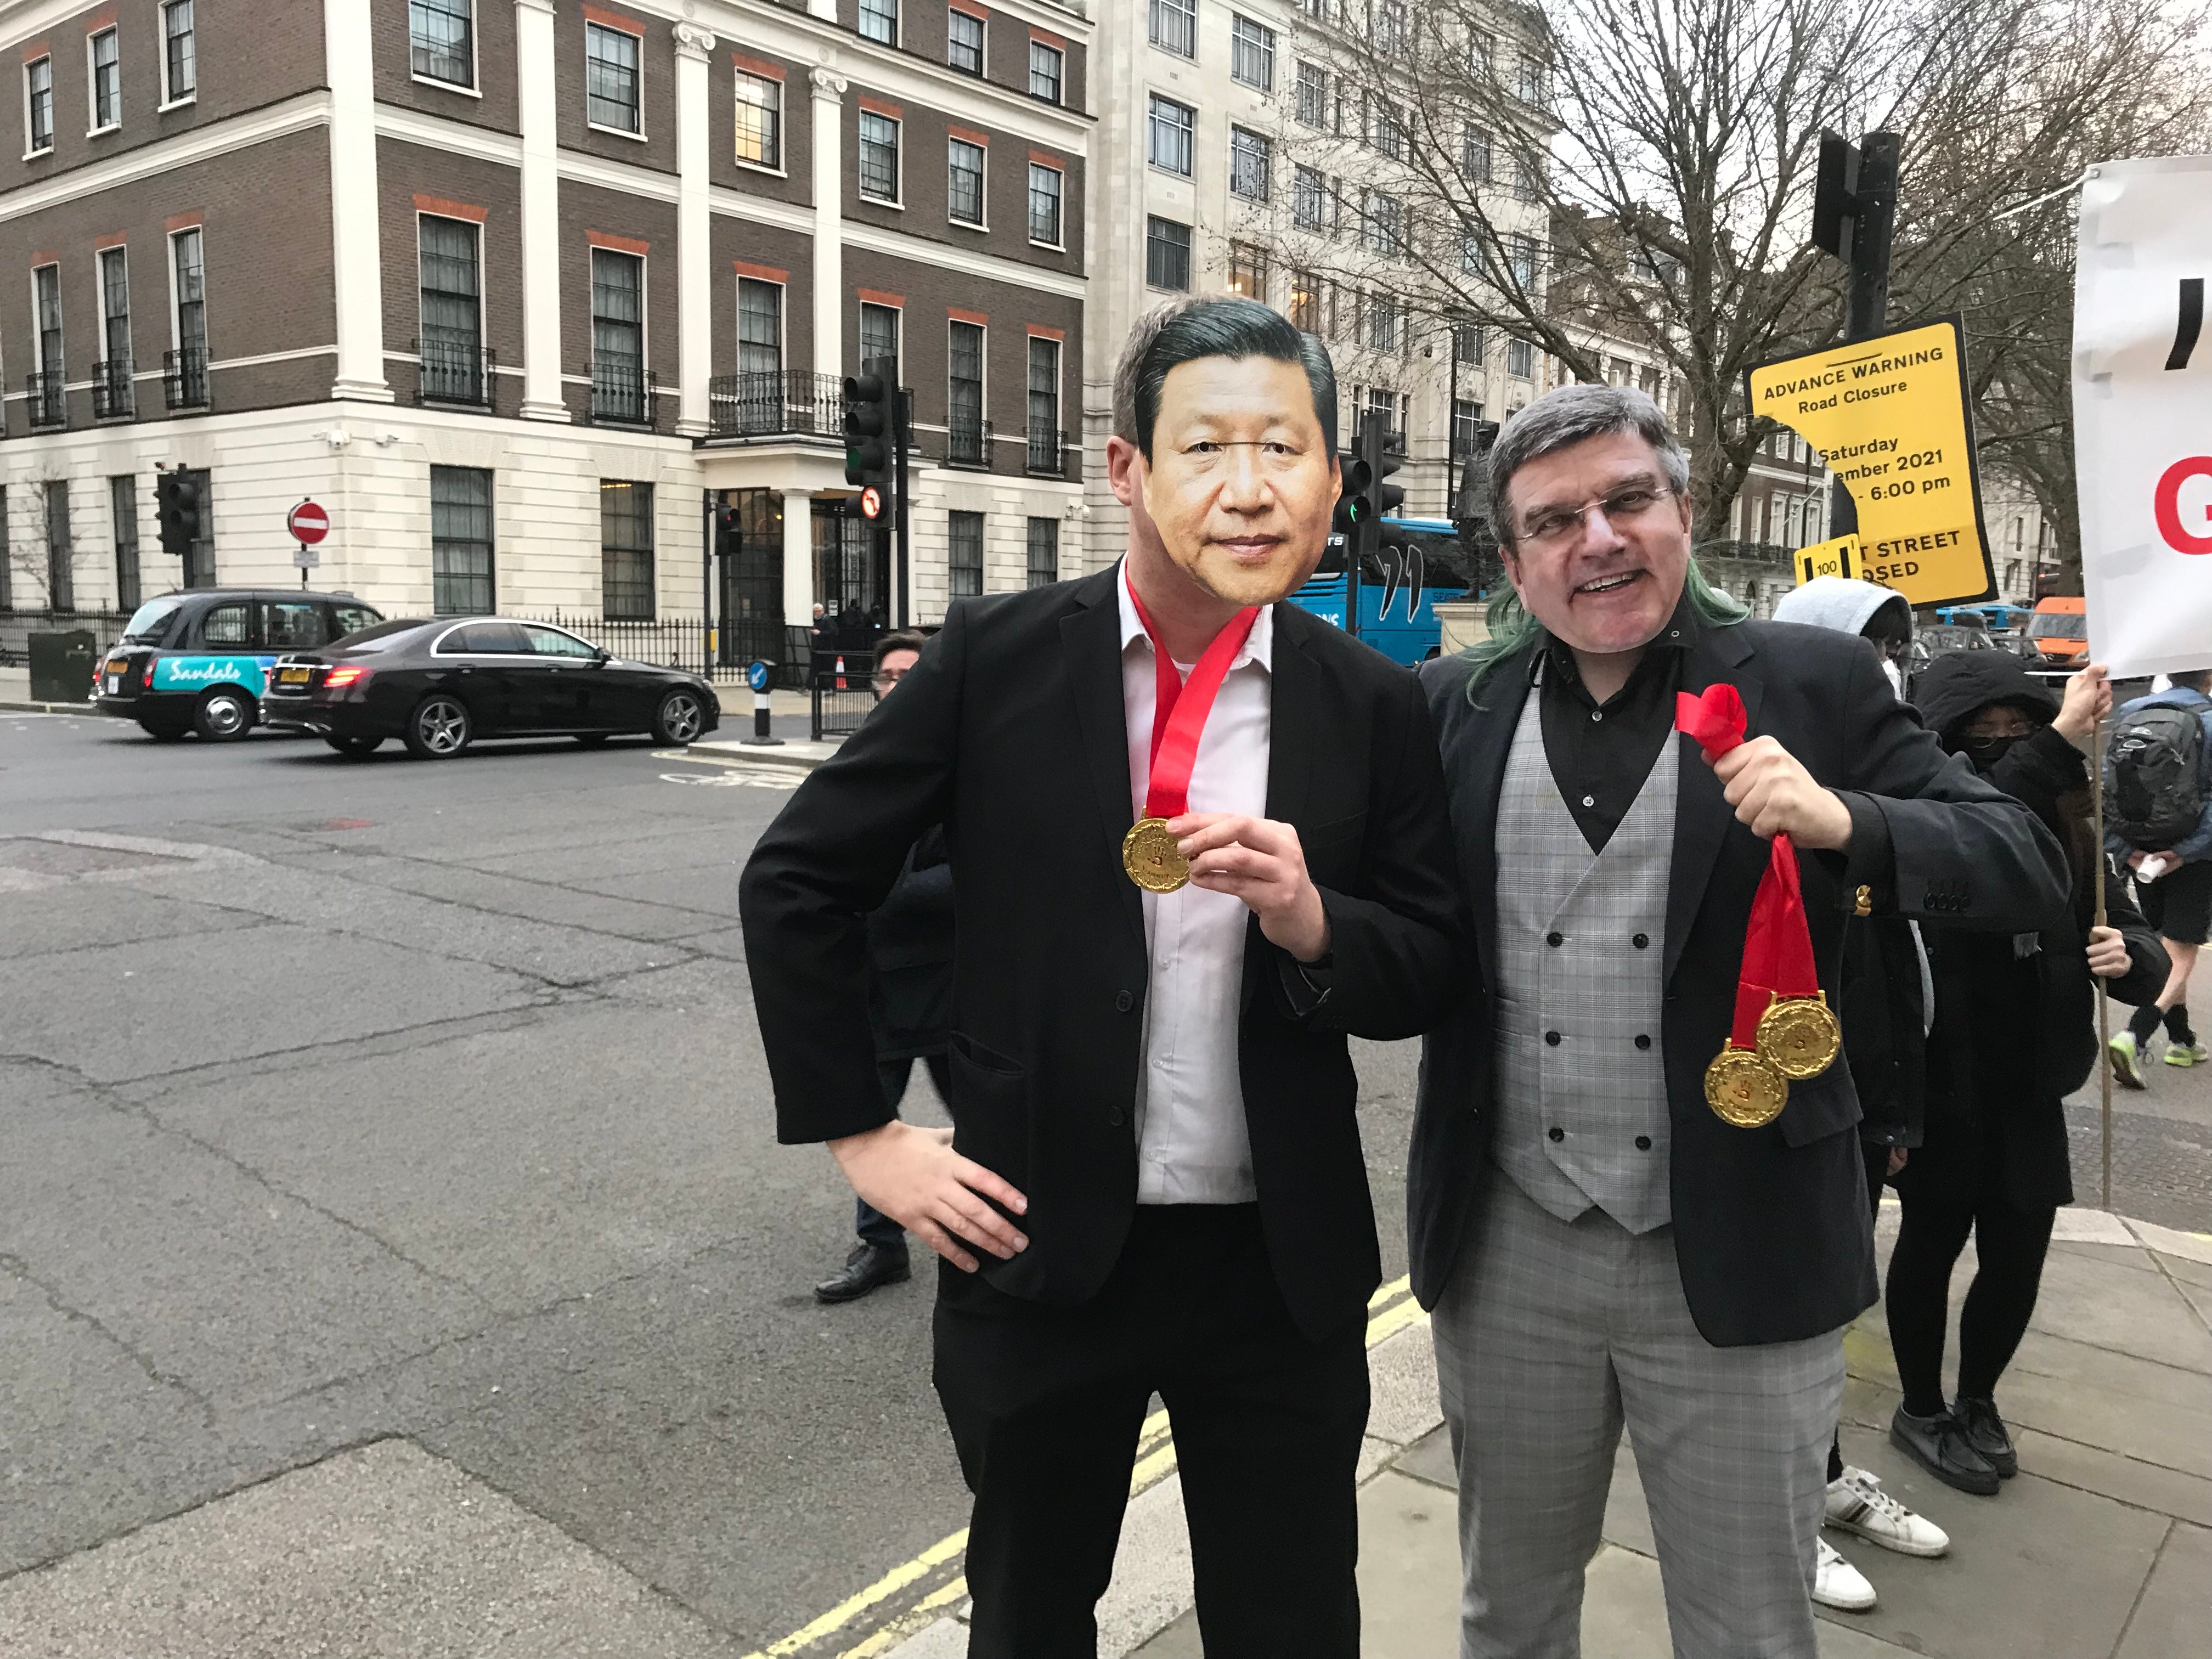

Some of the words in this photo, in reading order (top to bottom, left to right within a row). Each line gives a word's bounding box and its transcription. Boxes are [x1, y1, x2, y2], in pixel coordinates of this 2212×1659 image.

[1764, 370, 1846, 400] ADVANCE
[1852, 347, 1943, 379] WARNING
[1798, 394, 1837, 414] Road
[1843, 381, 1908, 404] Closure
[1818, 438, 1898, 462] Saturday
[1897, 449, 1943, 471] 2021
[1870, 480, 1915, 500] 6:00
[1922, 477, 1951, 494] pm
[1876, 531, 1960, 558] STREET
[1816, 560, 1837, 575] 100
[169, 660, 242, 681] Sandals
